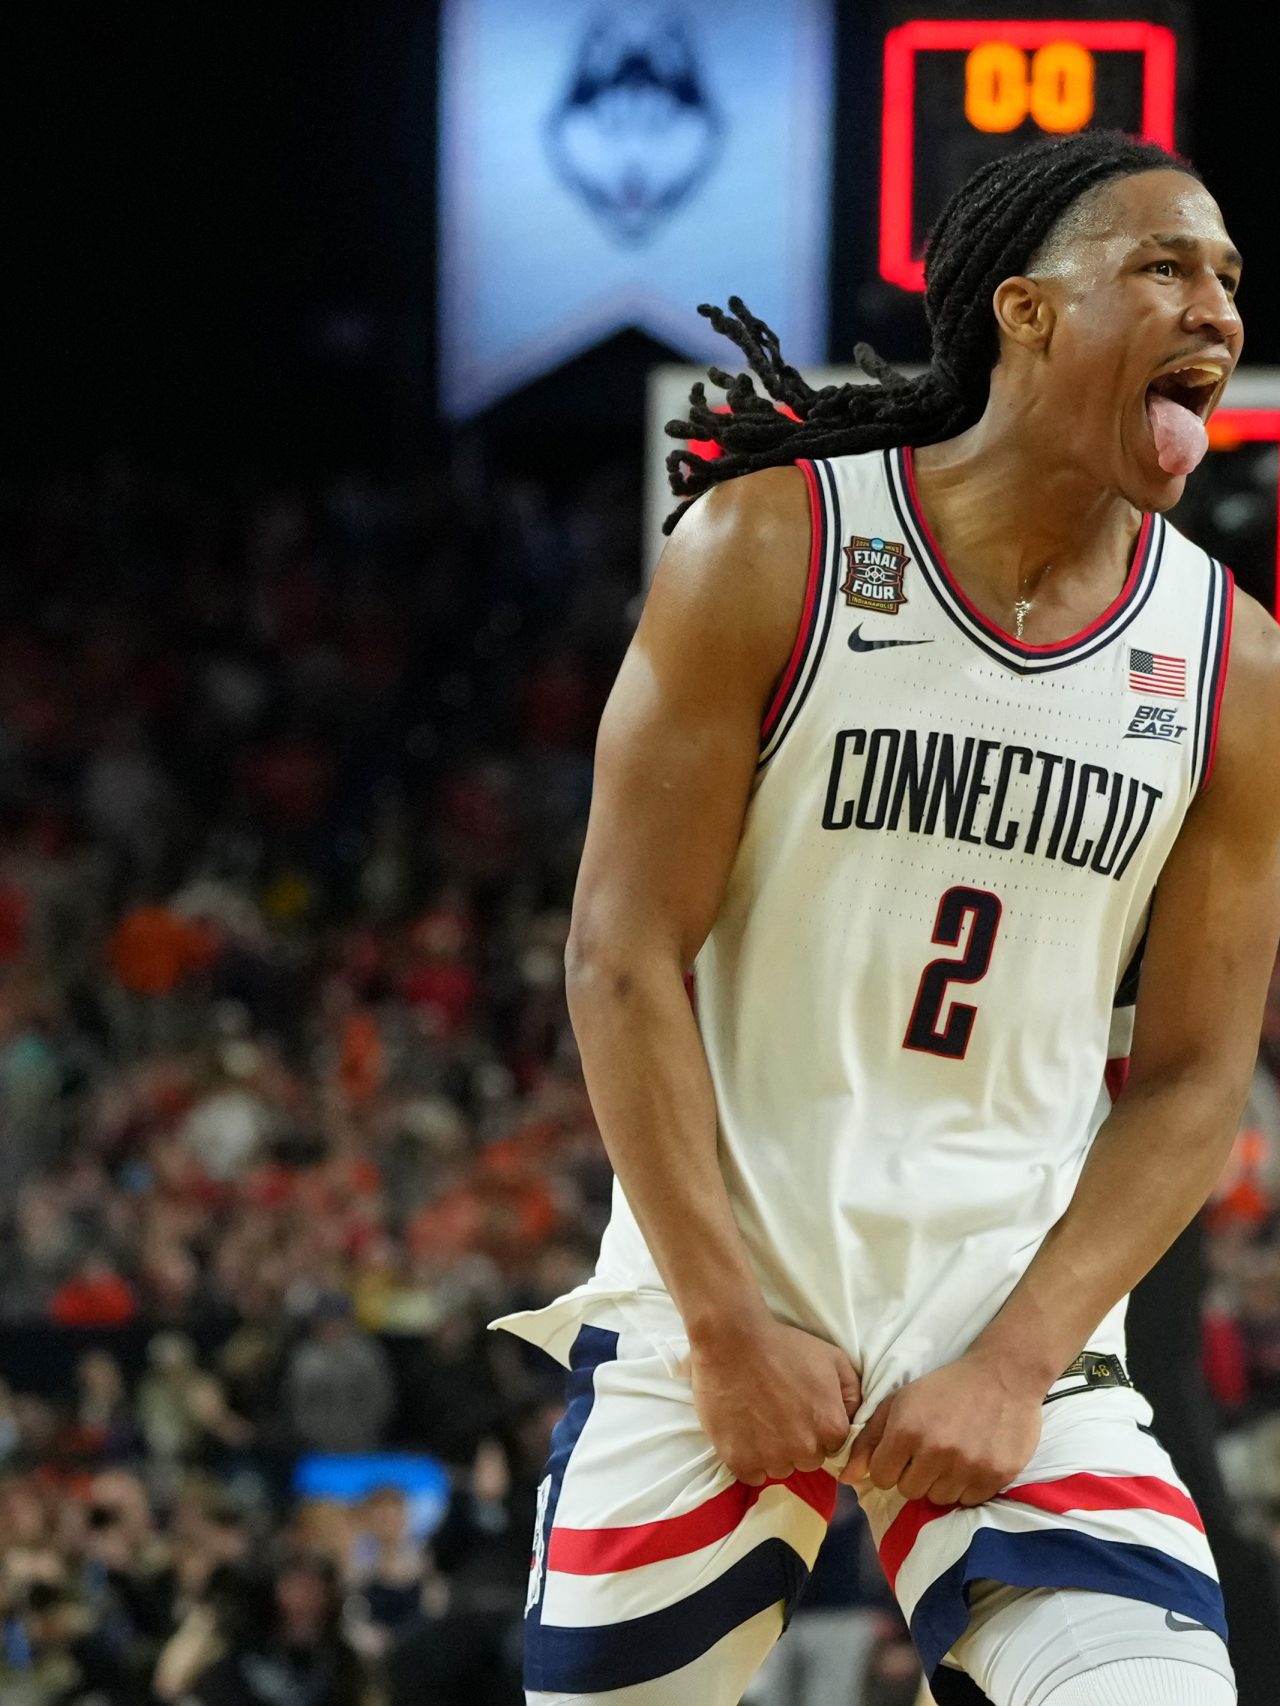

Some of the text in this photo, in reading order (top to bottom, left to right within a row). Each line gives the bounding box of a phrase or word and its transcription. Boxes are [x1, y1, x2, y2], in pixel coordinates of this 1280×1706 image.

[965, 41, 1094, 133] 00
[853, 550, 898, 570] FINAL
[852, 580, 895, 600] FOUR
[851, 596, 894, 610] INDIANAPOLIS
[1134, 705, 1177, 722] BIG
[1127, 719, 1187, 738] EAST
[821, 728, 1163, 881] CONNECTICUT
[902, 886, 1003, 1060] 2
